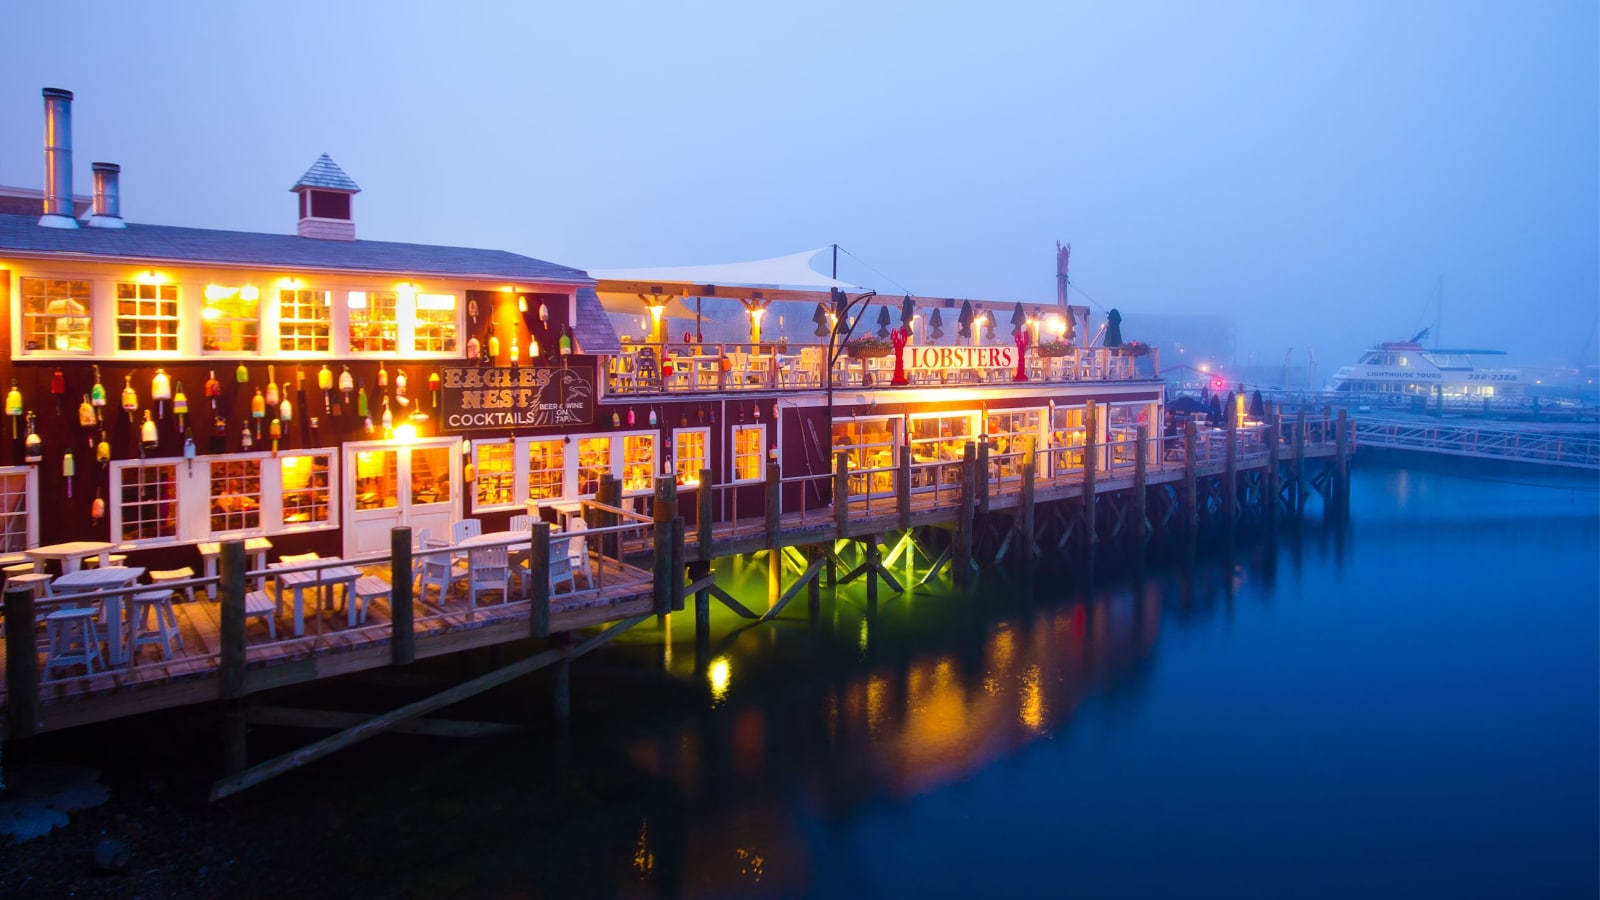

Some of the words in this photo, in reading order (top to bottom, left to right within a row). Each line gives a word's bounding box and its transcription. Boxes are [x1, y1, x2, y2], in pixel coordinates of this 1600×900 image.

[911, 347, 1012, 368] LOBSTERS
[444, 368, 551, 388] EAGLES
[462, 389, 532, 409] NEST
[448, 411, 535, 427] COCKTAILS
[556, 415, 570, 423] TAP
